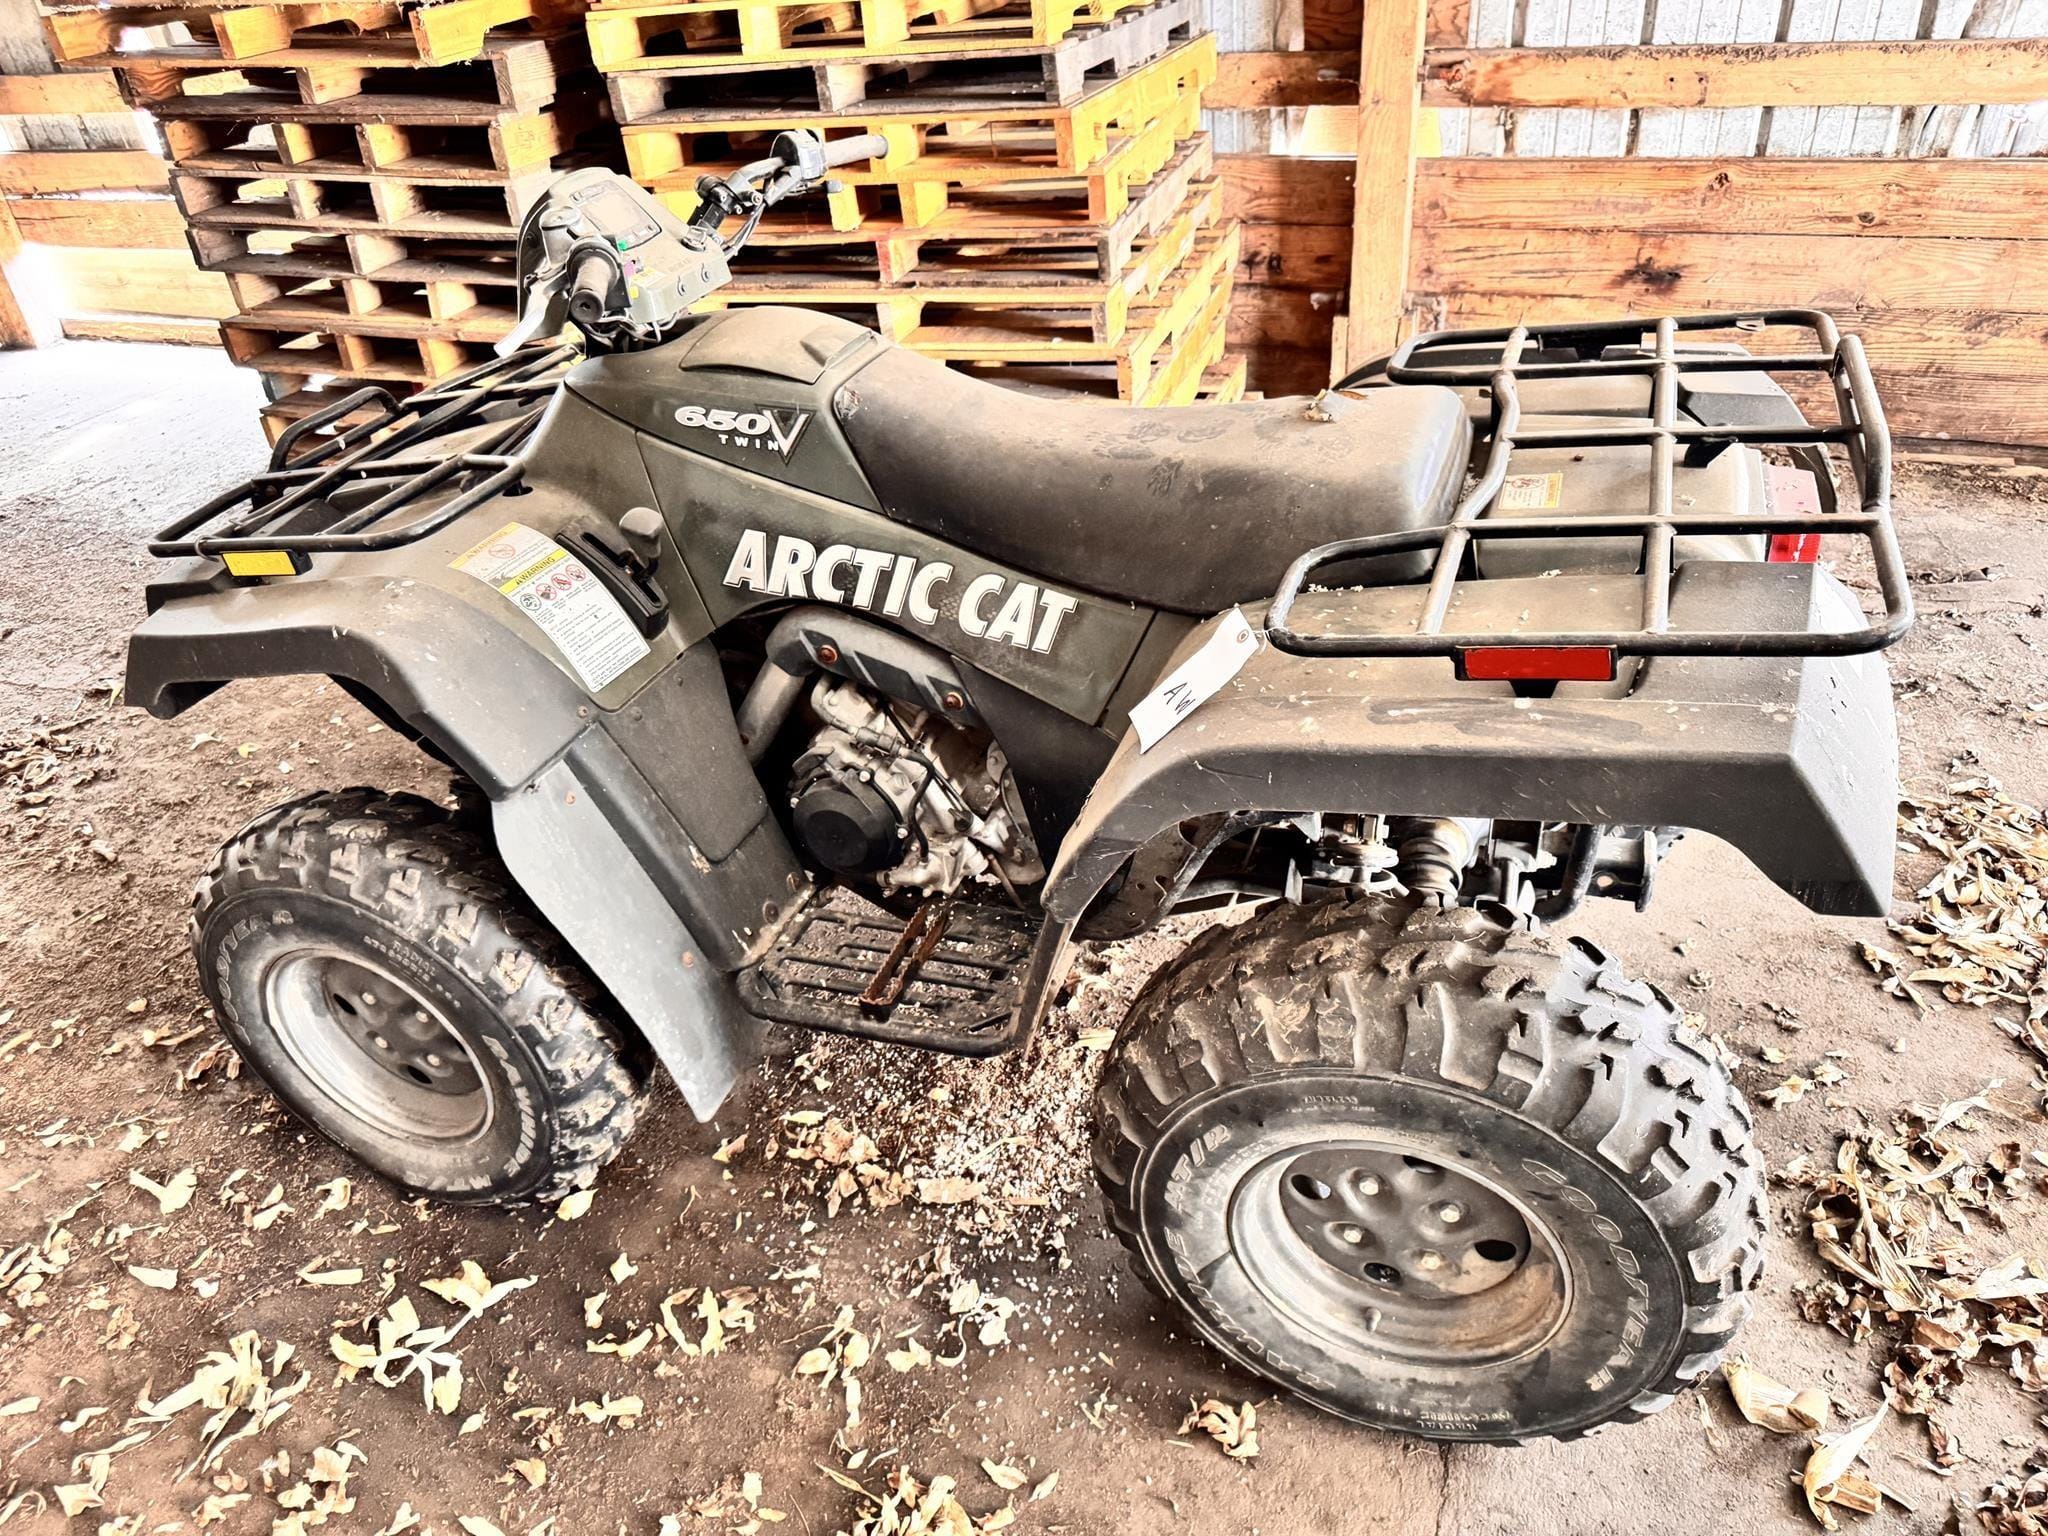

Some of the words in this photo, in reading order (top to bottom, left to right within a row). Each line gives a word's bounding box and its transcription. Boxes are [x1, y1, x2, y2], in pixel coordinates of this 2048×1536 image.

[718, 433, 779, 452] TWIN
[519, 556, 556, 582] WARNING
[723, 528, 955, 626] ARCTIC
[957, 572, 1079, 655] CAT
